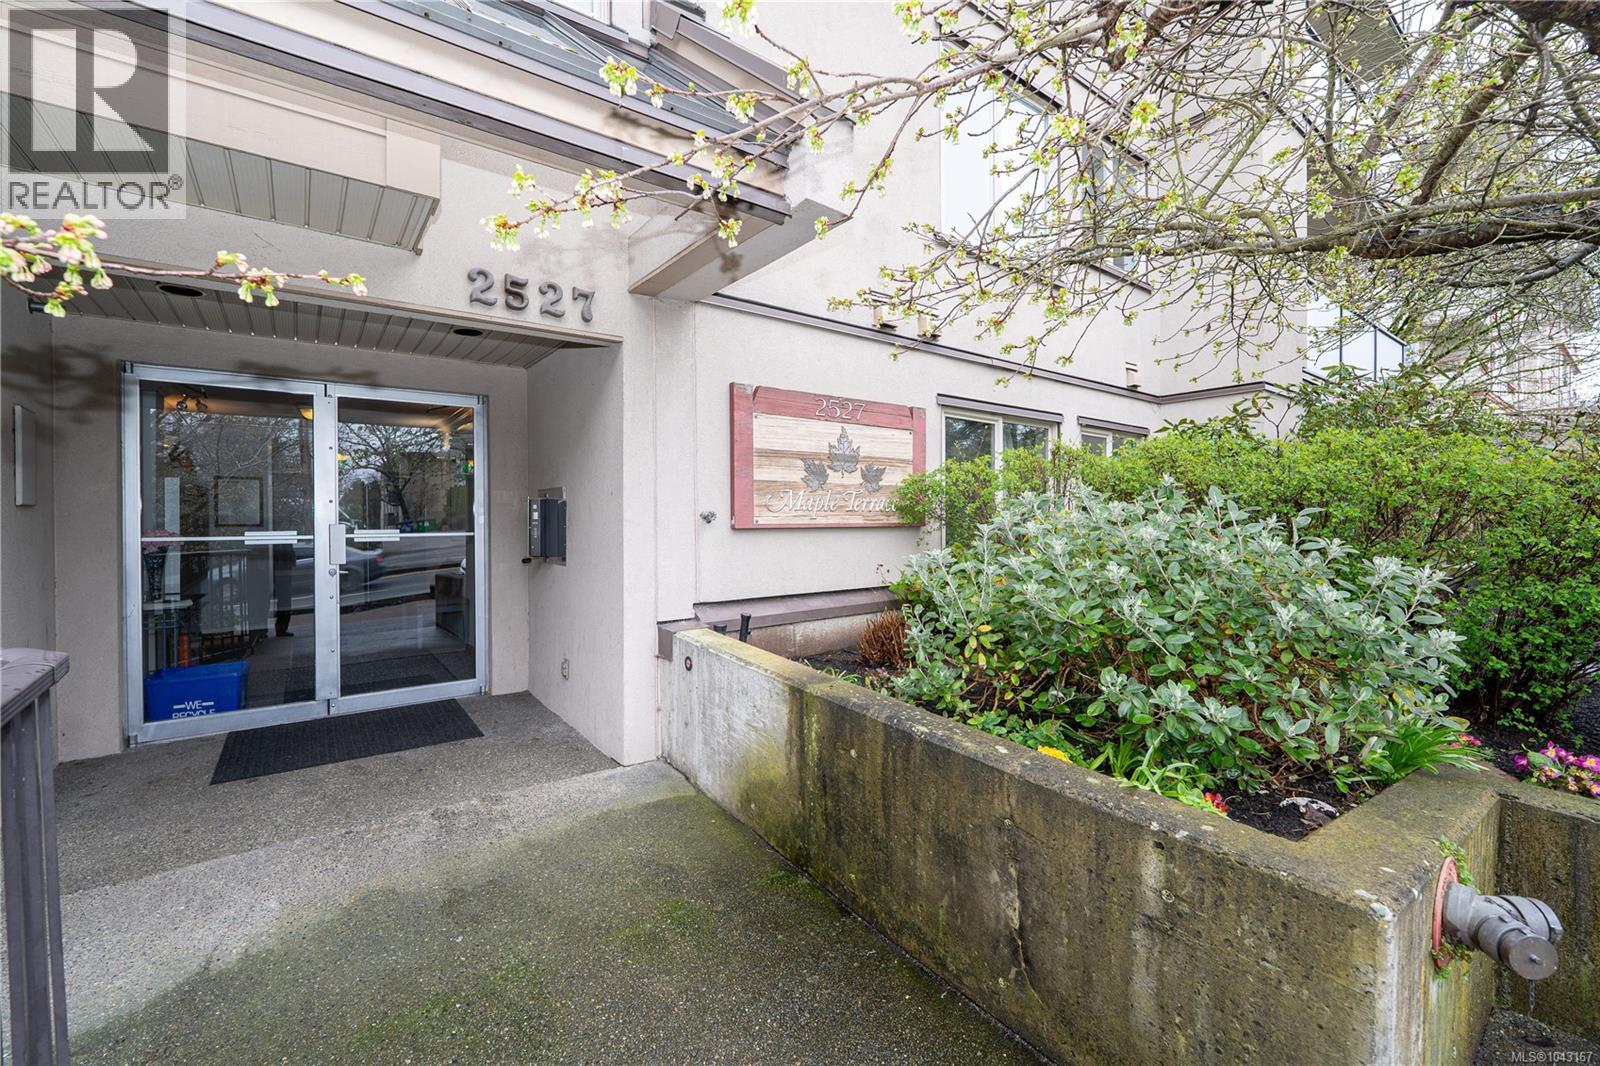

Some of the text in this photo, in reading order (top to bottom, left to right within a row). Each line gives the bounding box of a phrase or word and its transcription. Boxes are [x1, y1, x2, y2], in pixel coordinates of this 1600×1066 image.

[467, 266, 596, 323] 2527
[814, 398, 866, 421] 2527
[766, 489, 839, 520] Maple
[184, 699, 202, 710] WE
